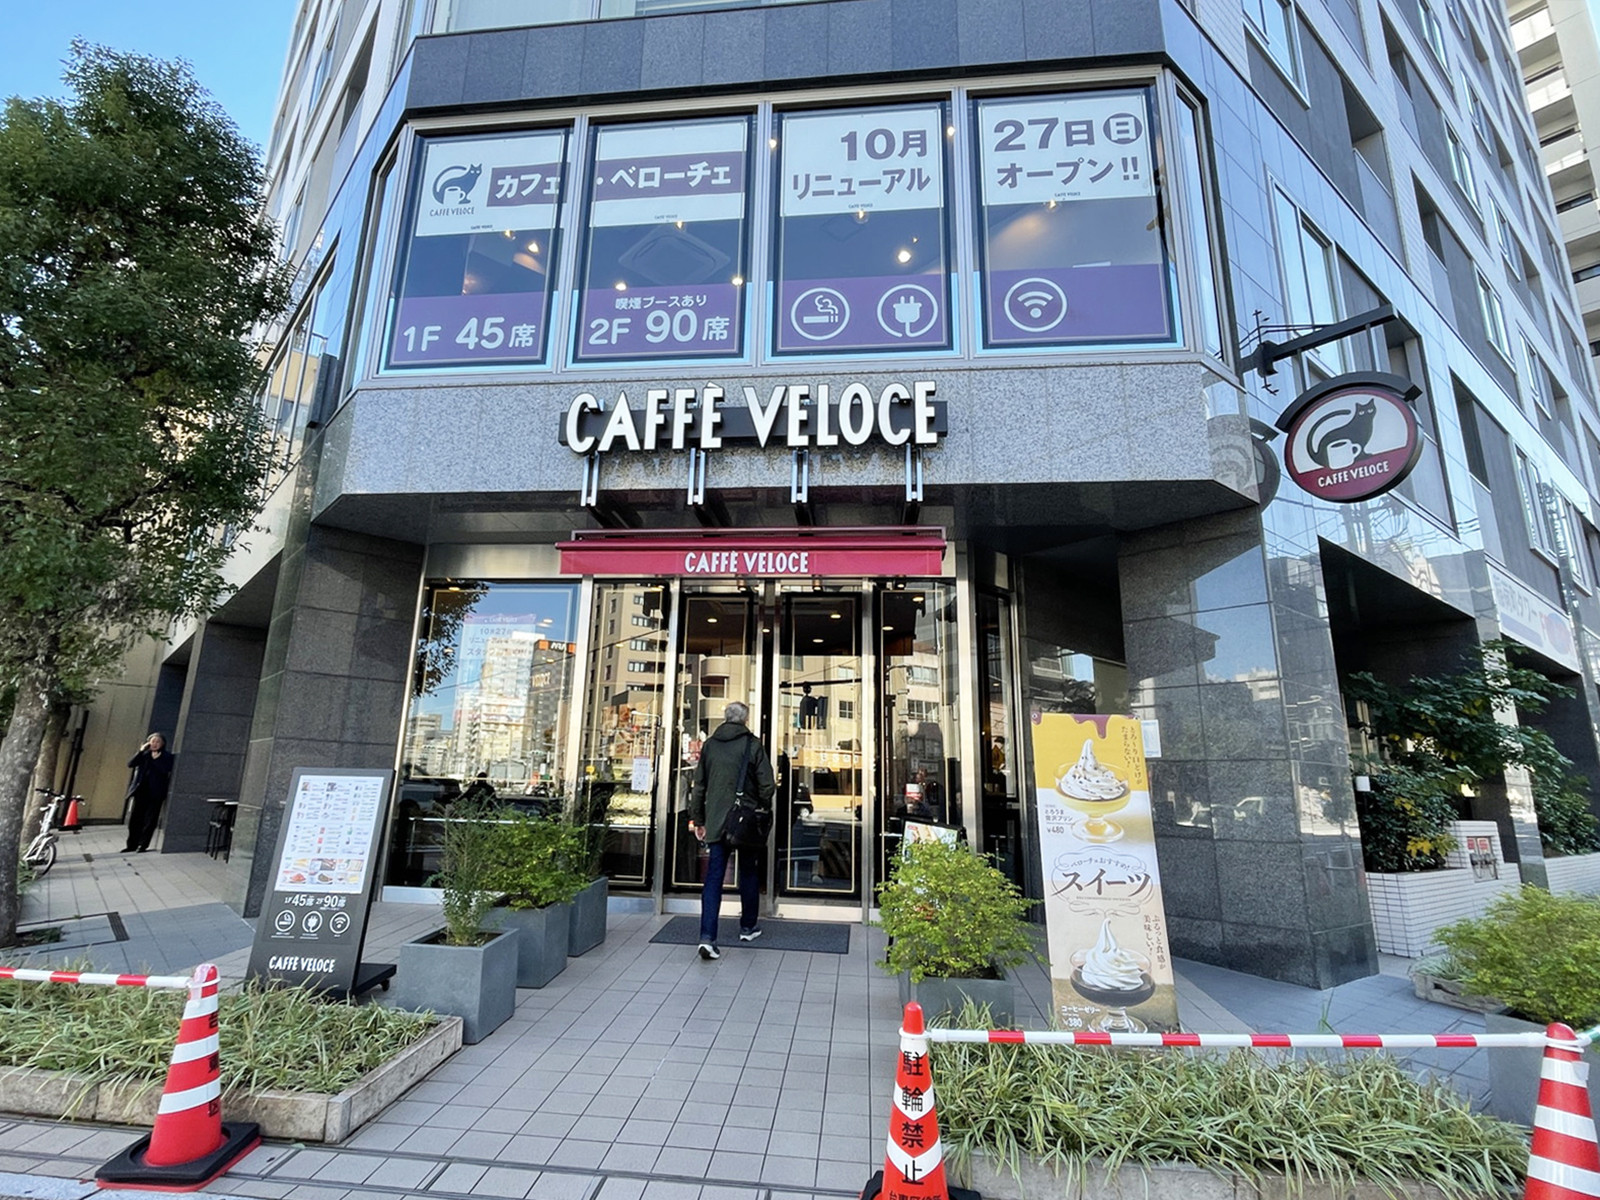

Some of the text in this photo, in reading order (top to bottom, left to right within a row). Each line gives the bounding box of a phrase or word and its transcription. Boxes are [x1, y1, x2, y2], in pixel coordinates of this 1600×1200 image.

[841, 128, 927, 161] 10月
[495, 174, 561, 199] カフェ
[792, 167, 931, 200] リニューアル
[615, 294, 707, 310] 喫煙ブースあり
[403, 316, 536, 352] 1F 45席
[588, 308, 730, 345] 2F 90席
[743, 380, 938, 448] VELOCE
[1350, 461, 1390, 479] VELOCE
[743, 551, 809, 573] VELOCE
[1050, 868, 1151, 897] スイーツ
[301, 957, 337, 974] VELOCE
[902, 1050, 924, 1186] 駐輪禁止
